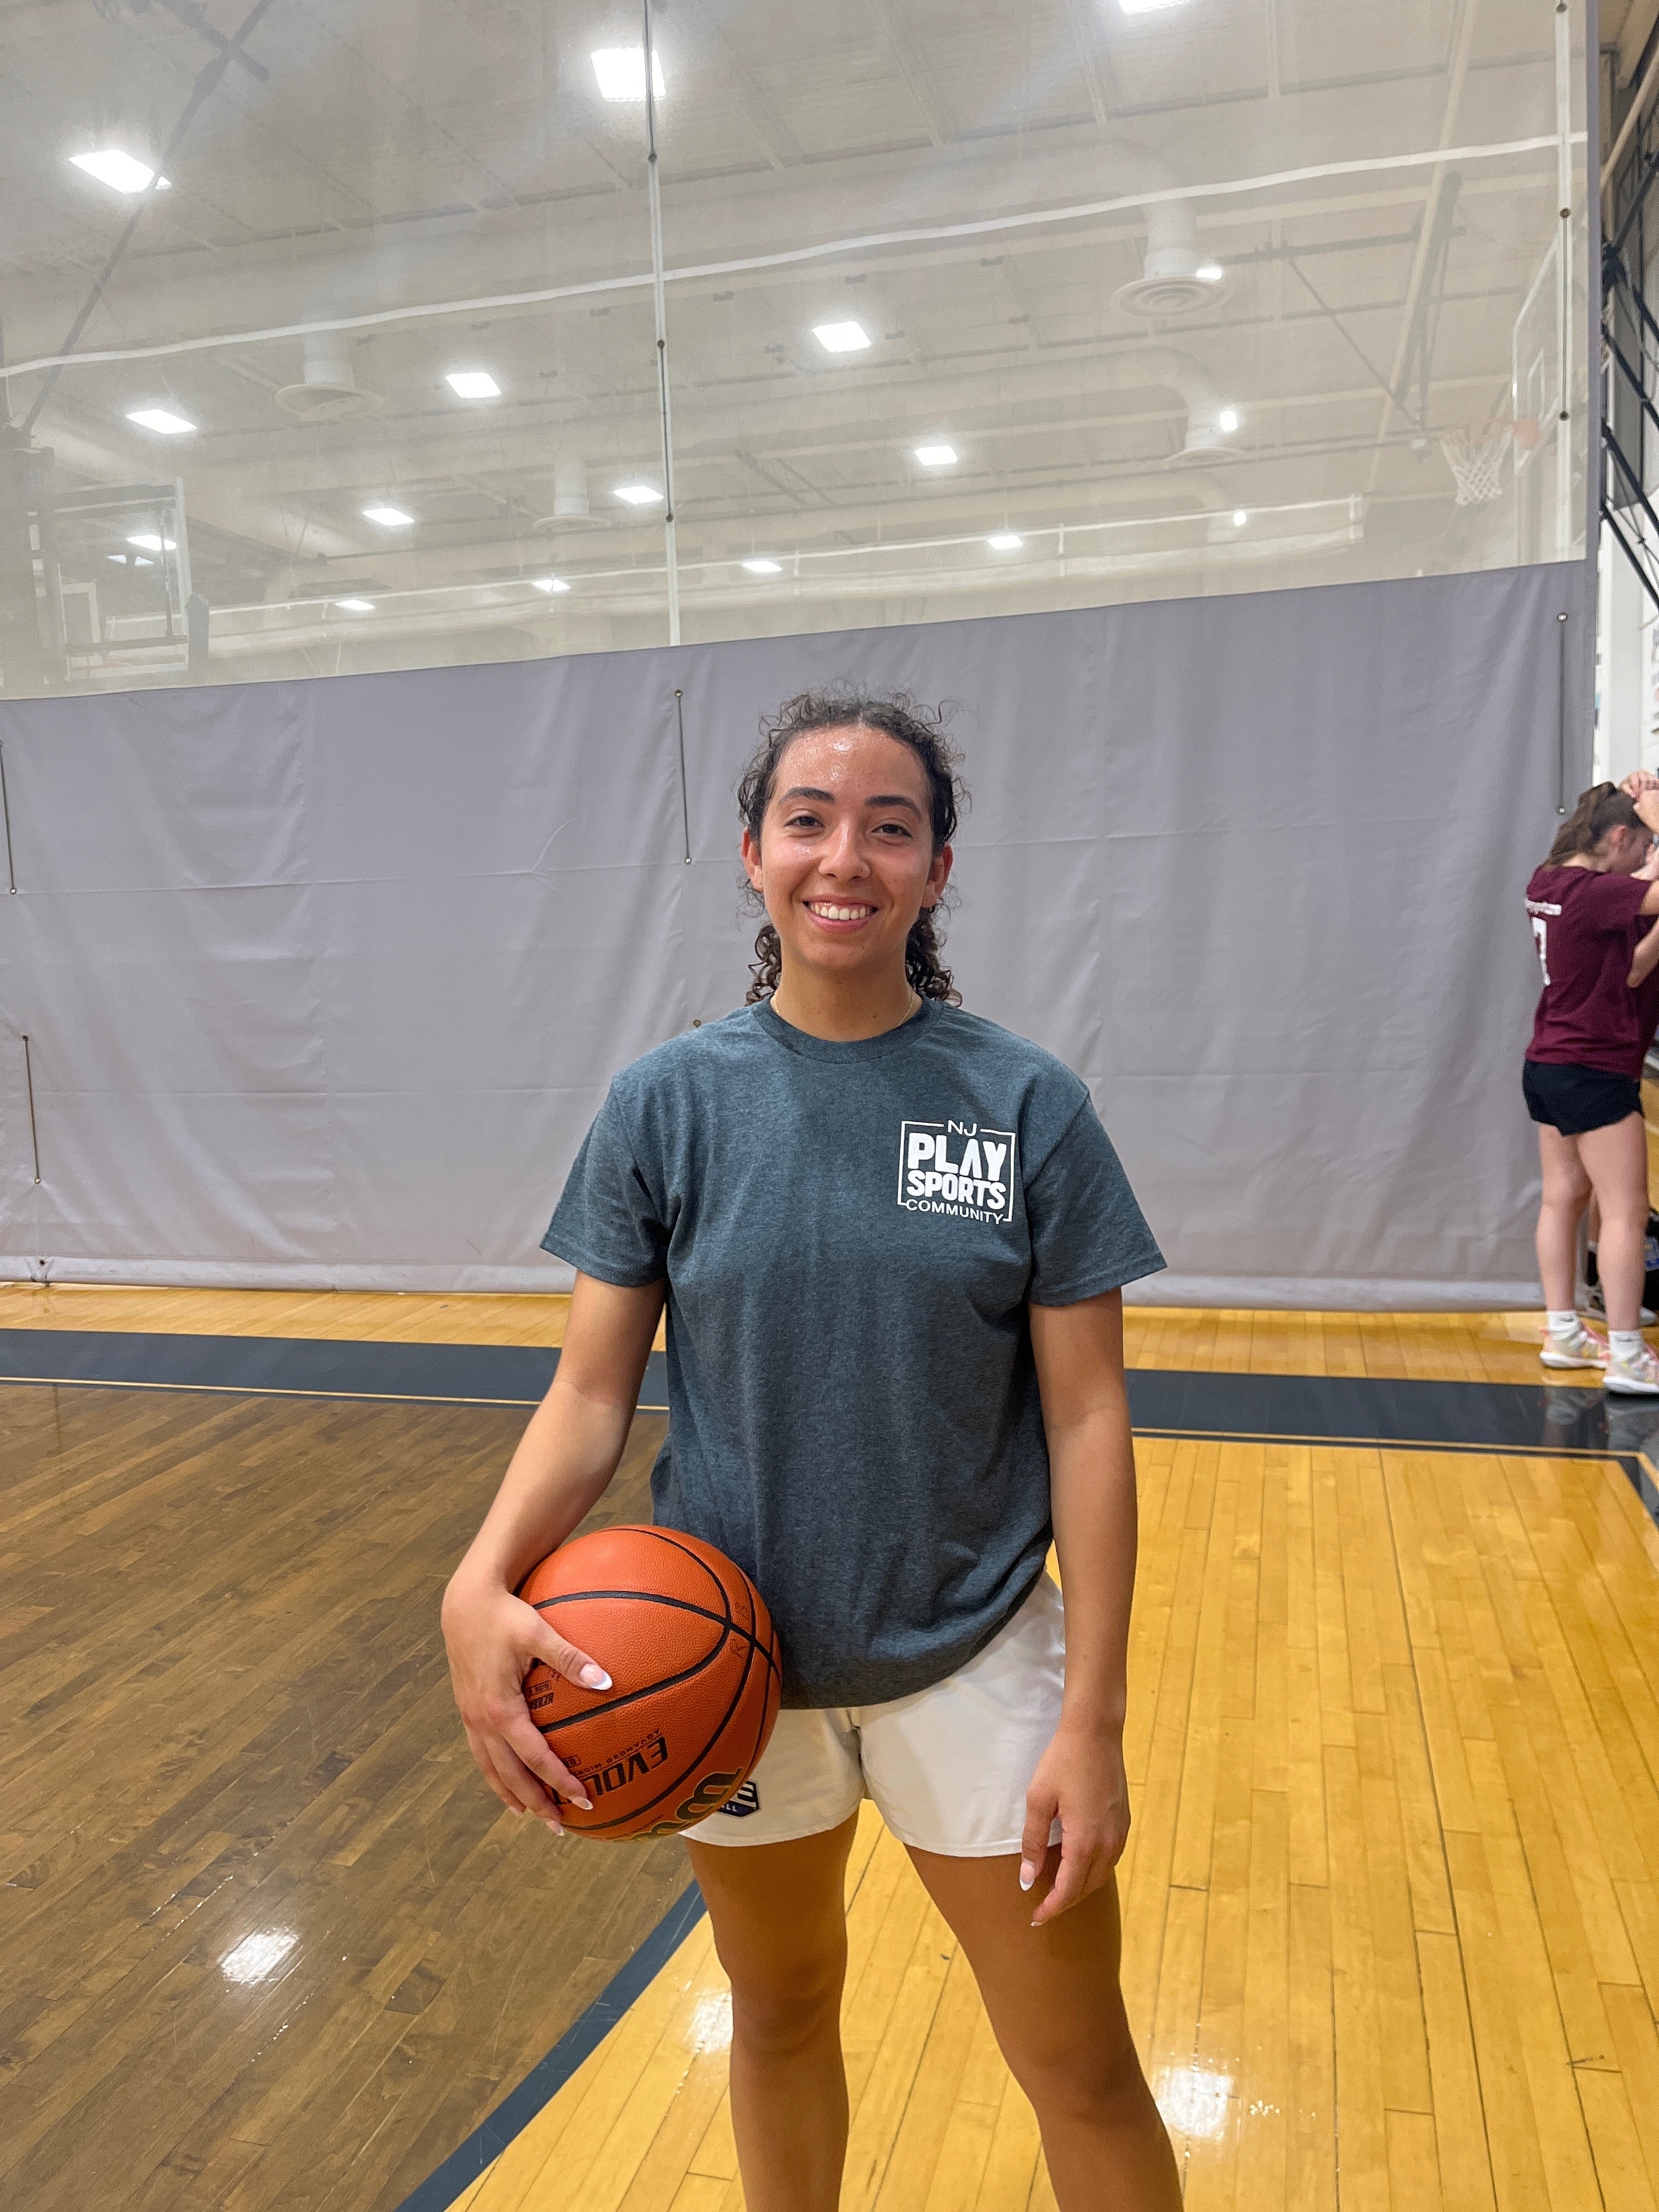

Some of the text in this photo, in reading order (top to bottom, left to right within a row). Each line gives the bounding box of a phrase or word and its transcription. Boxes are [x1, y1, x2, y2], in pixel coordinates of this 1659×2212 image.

[947, 1120, 977, 1136] NJ
[907, 1132, 1007, 1181] PLAY
[906, 1170, 1006, 1210] SPORTS
[906, 1199, 1003, 1224] COMMUNITY
